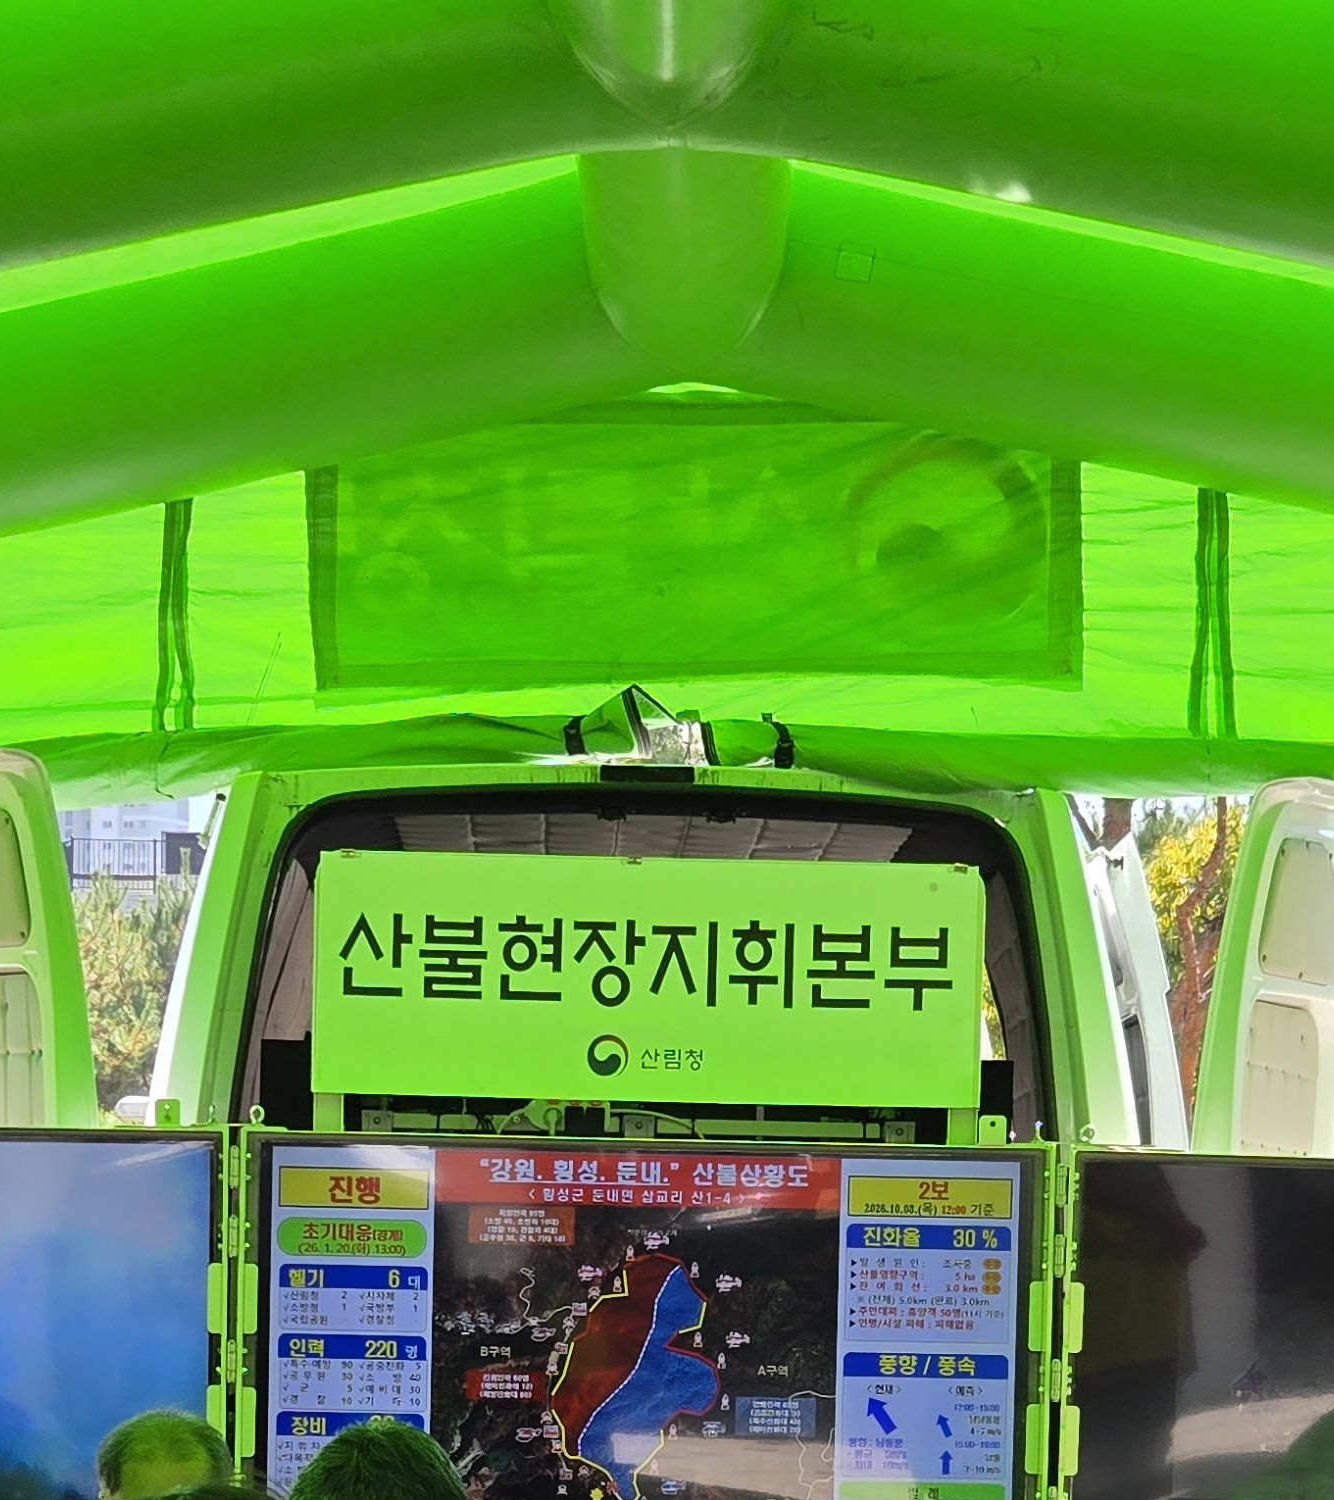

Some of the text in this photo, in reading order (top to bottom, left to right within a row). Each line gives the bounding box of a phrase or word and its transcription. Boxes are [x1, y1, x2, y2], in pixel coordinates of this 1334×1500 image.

[338, 911, 954, 1012] 산불현장지휘본부
[641, 1049, 703, 1071] 산림청
[693, 1165, 809, 1187] 산불상황도
[329, 1176, 380, 1204] 진행
[543, 1188, 583, 1202] 횡성군
[592, 1190, 633, 1203] 둔내면
[919, 1181, 949, 1200] 2보
[971, 1204, 994, 1216] 기준
[864, 1227, 920, 1247] 진화율
[953, 1229, 975, 1248] 30
[289, 1269, 324, 1288] 헬기
[388, 1269, 400, 1288] 6
[342, 1291, 347, 1299] 2
[413, 1292, 419, 1300] 2
[289, 1339, 324, 1358] 인력
[365, 1340, 397, 1358] 220
[480, 1346, 511, 1357] B구역
[757, 1365, 788, 1377] A구역
[879, 1355, 917, 1375] 풍향
[938, 1356, 975, 1376] 풍속
[291, 1416, 326, 1435] 장비
